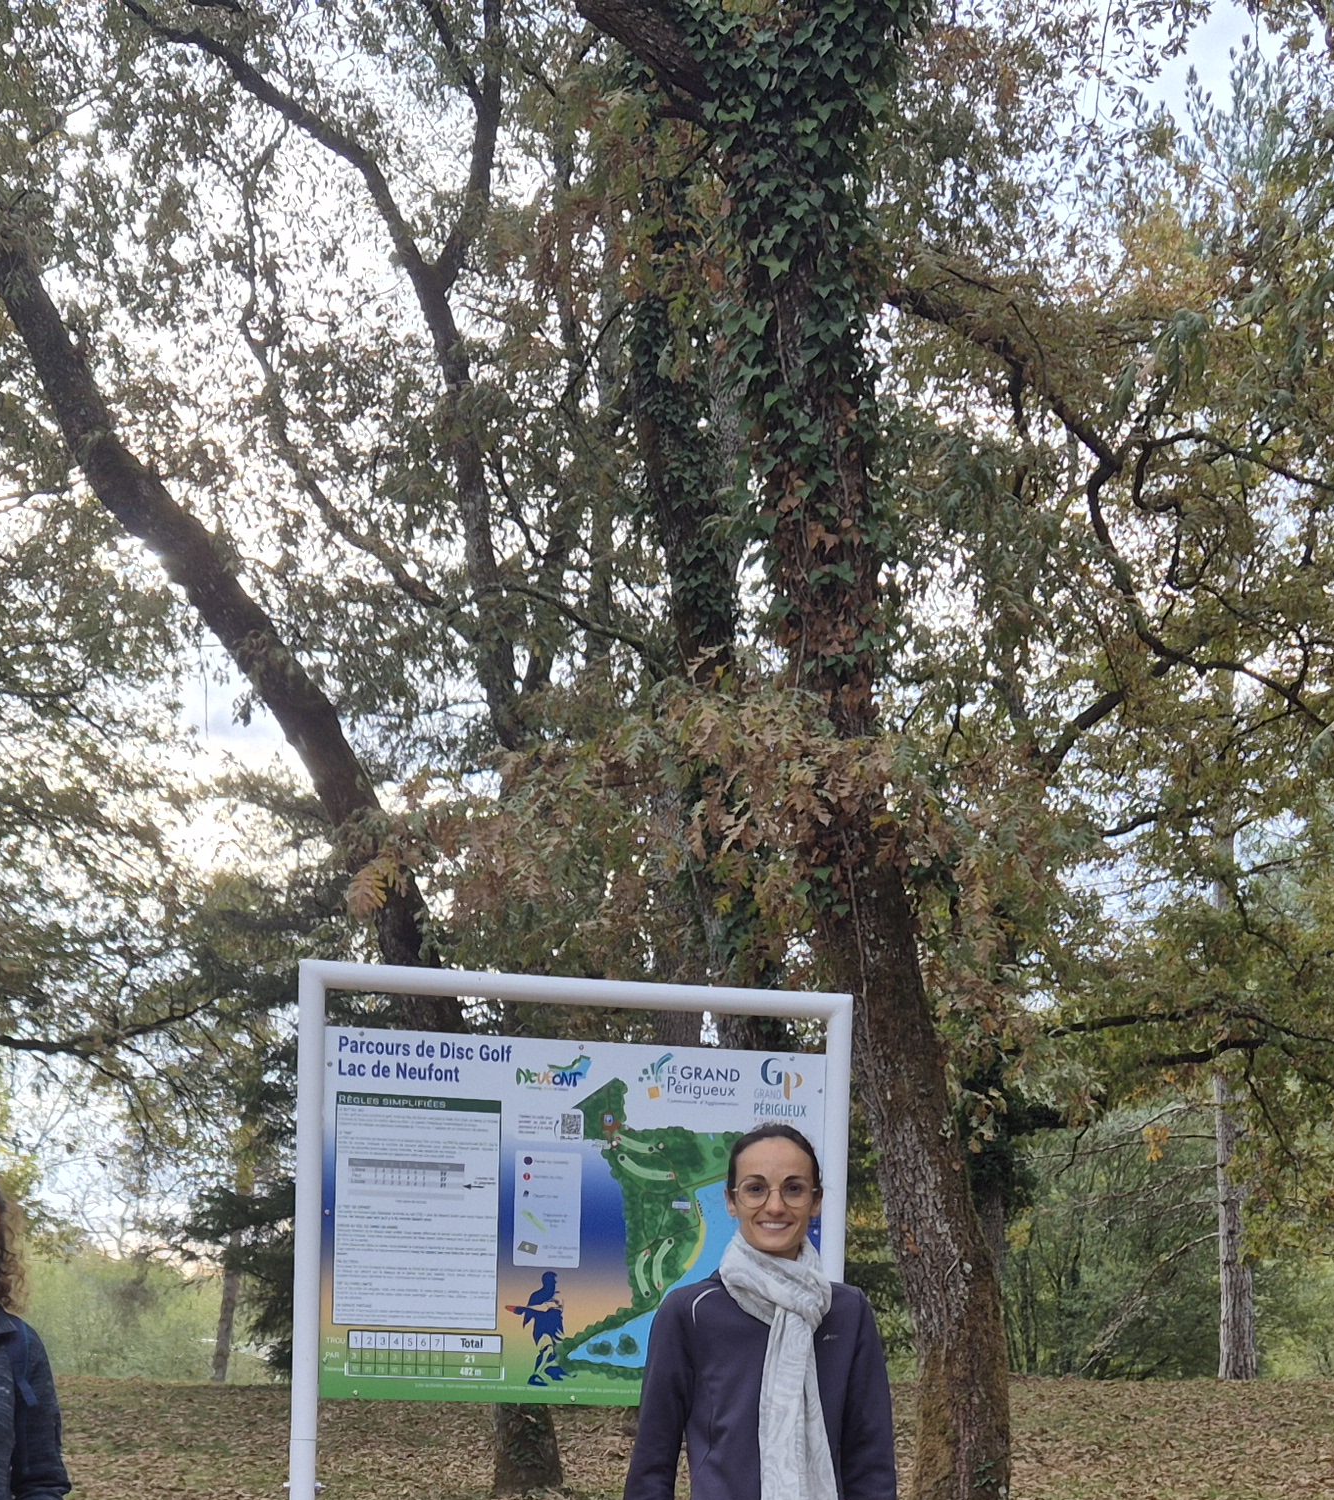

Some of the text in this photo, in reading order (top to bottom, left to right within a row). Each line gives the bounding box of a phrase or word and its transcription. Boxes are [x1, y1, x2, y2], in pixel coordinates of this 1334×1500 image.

[338, 1035, 513, 1063] Parcours de Disc Golf
[338, 1058, 460, 1082] Lac de Neufont
[667, 1066, 740, 1082] LE GRAND
[667, 1076, 735, 1099] Périgueux
[753, 1088, 781, 1100] GRAND
[382, 1096, 447, 1109] SIMPLIFIÉES
[753, 1100, 807, 1117] PÉRIGUEUX
[327, 1336, 345, 1344] TROU
[354, 1336, 358, 1344] 1
[367, 1337, 372, 1345] 2
[380, 1337, 385, 1345] 3
[407, 1338, 413, 1346] 5
[435, 1339, 440, 1347] 7
[460, 1338, 483, 1348] Total
[465, 1355, 475, 1363] 21
